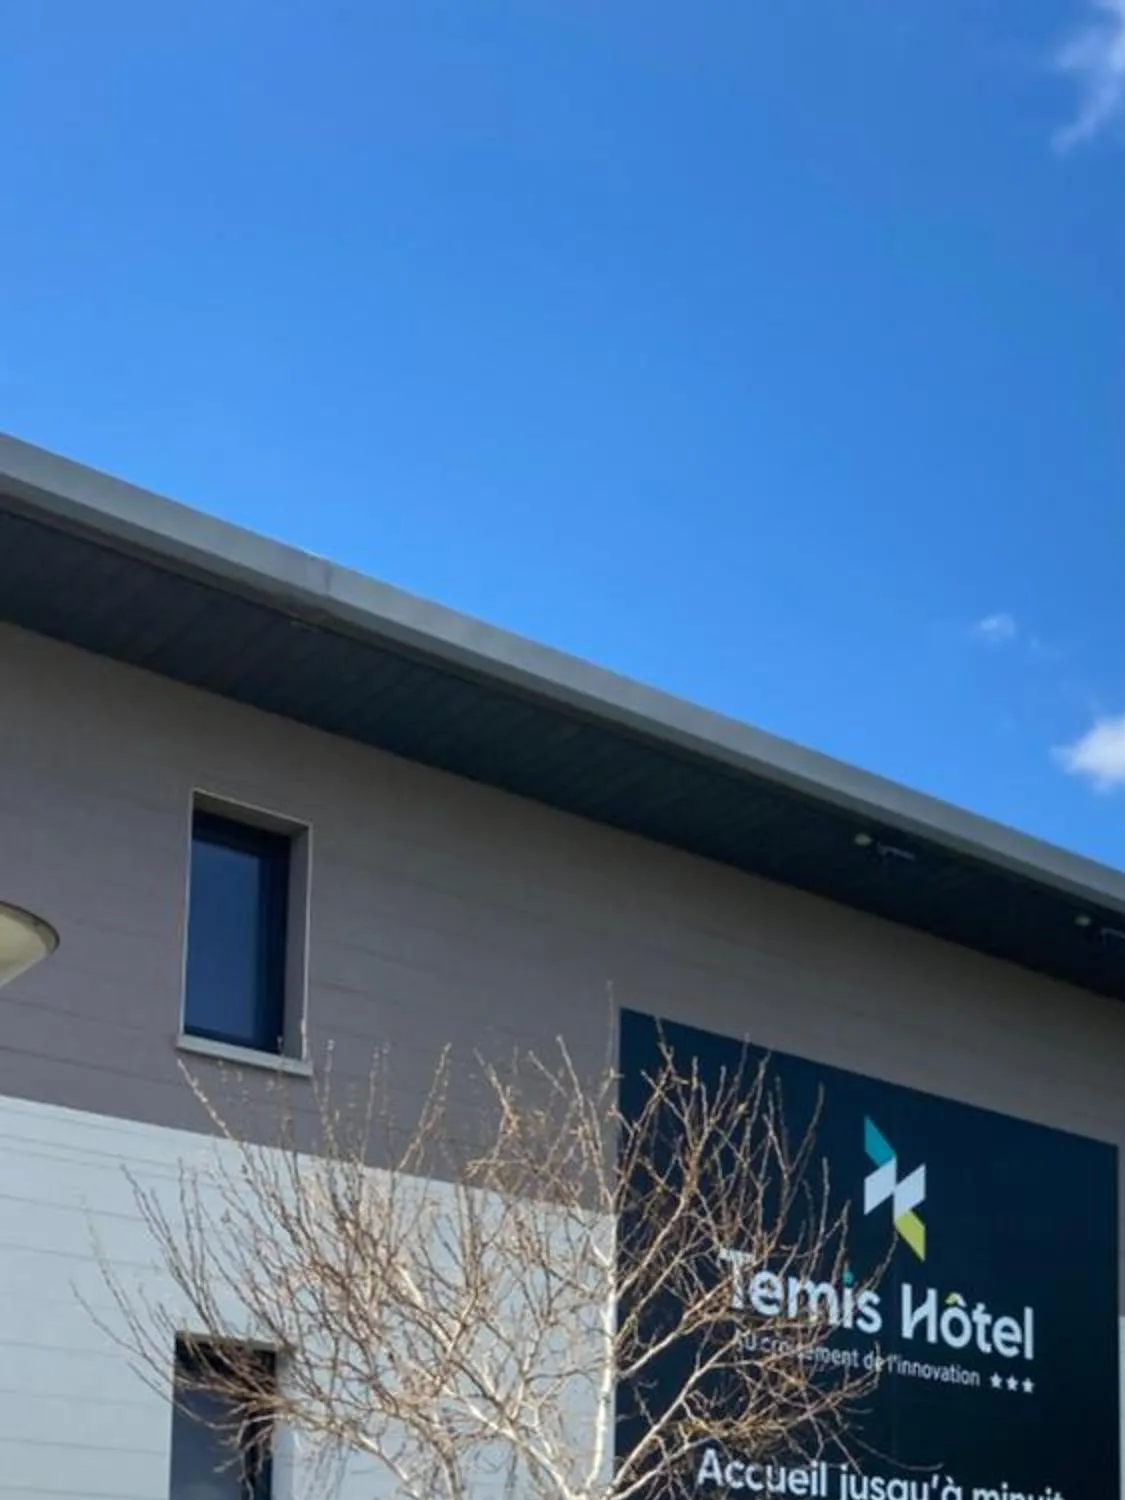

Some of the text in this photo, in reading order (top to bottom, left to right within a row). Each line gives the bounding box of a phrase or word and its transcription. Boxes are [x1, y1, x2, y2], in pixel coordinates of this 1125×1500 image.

[720, 1248, 1034, 1360] Temis Hôtel
[886, 1352, 981, 1386] l'innovation
[698, 1448, 828, 1498] Accueil
